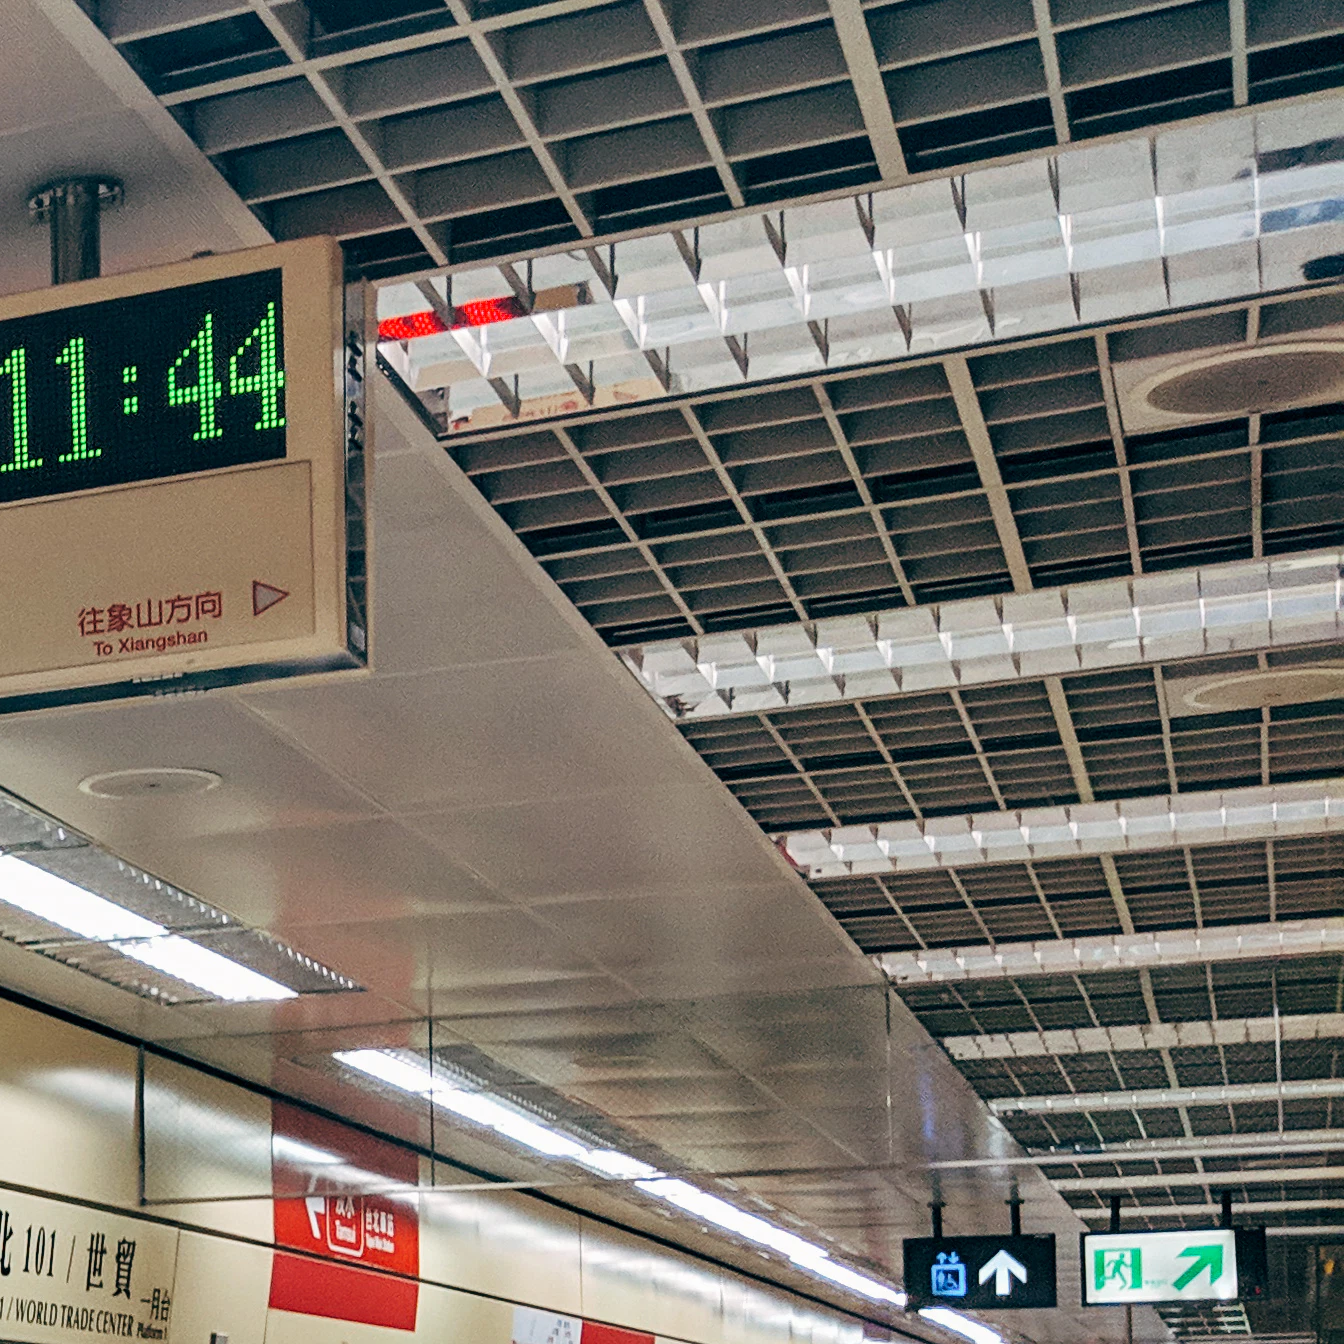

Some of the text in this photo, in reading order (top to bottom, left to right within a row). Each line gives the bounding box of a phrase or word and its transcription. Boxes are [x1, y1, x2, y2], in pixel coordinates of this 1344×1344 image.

[77, 591, 222, 637] 往象山方向
[93, 629, 208, 656] To Xiangshan
[14, 1297, 58, 1327] WORLD
[60, 1304, 95, 1332] TRADE
[96, 1310, 133, 1338] CENTER
